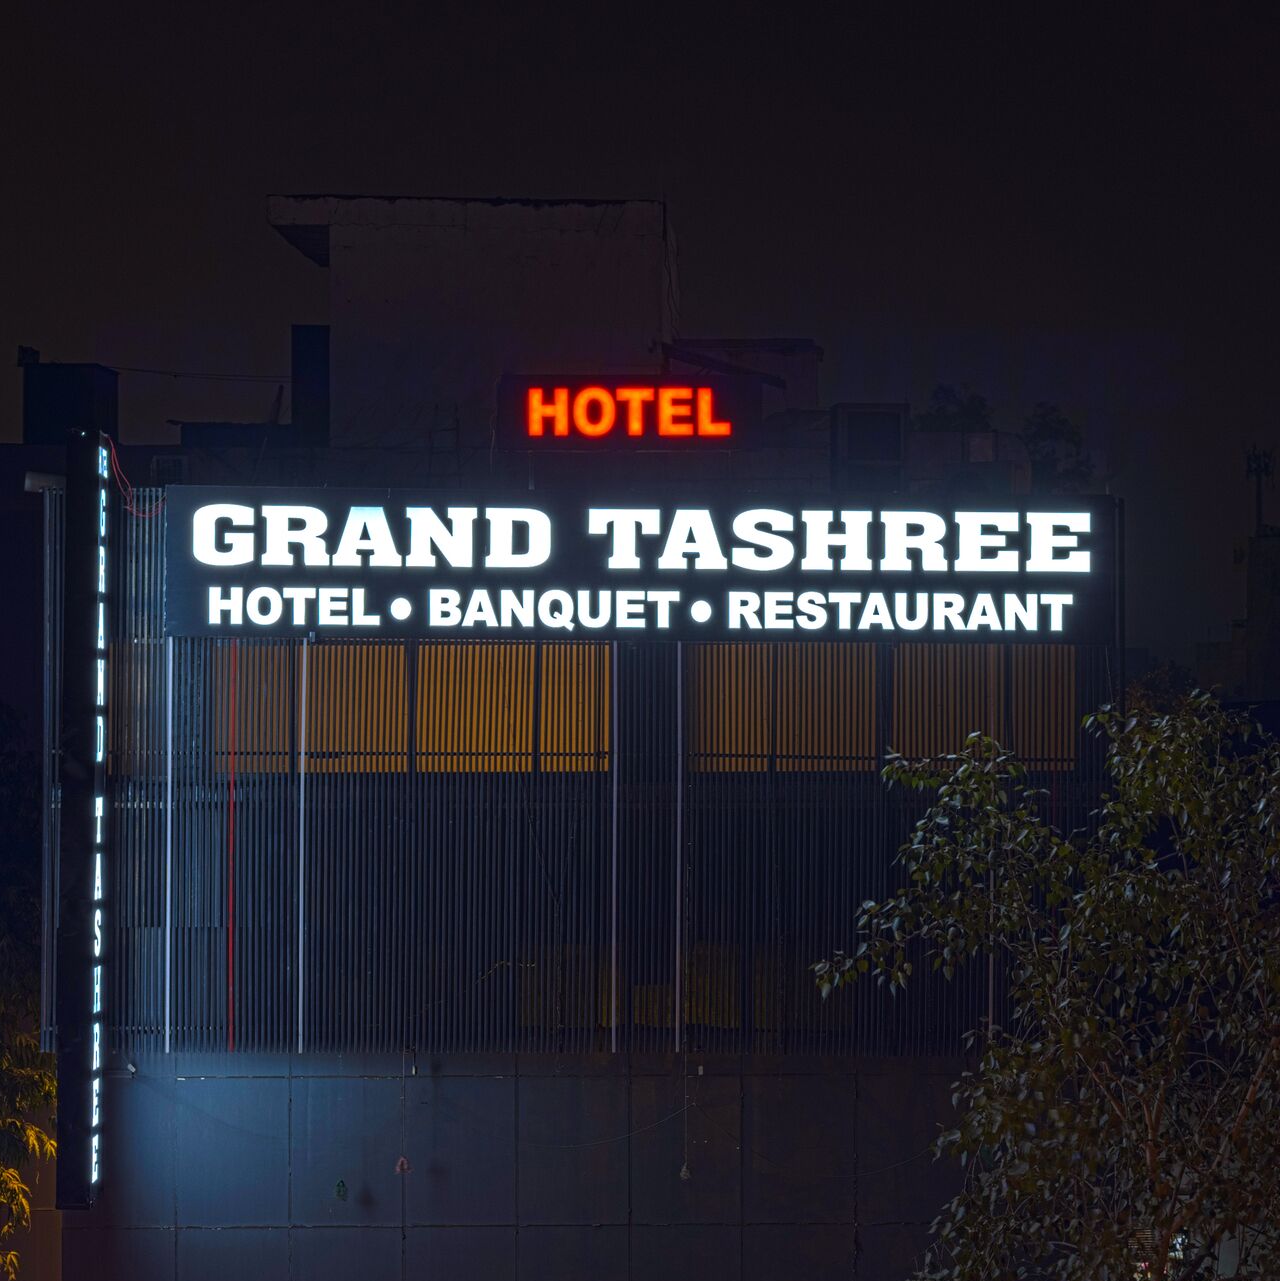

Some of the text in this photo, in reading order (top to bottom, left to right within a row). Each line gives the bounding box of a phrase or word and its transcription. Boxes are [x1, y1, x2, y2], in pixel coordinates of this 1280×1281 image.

[528, 386, 731, 437] HOTEL
[192, 503, 1091, 573] GRAND TASHREE
[208, 586, 1074, 633] HOTEL BANQUET RESTAURANT
